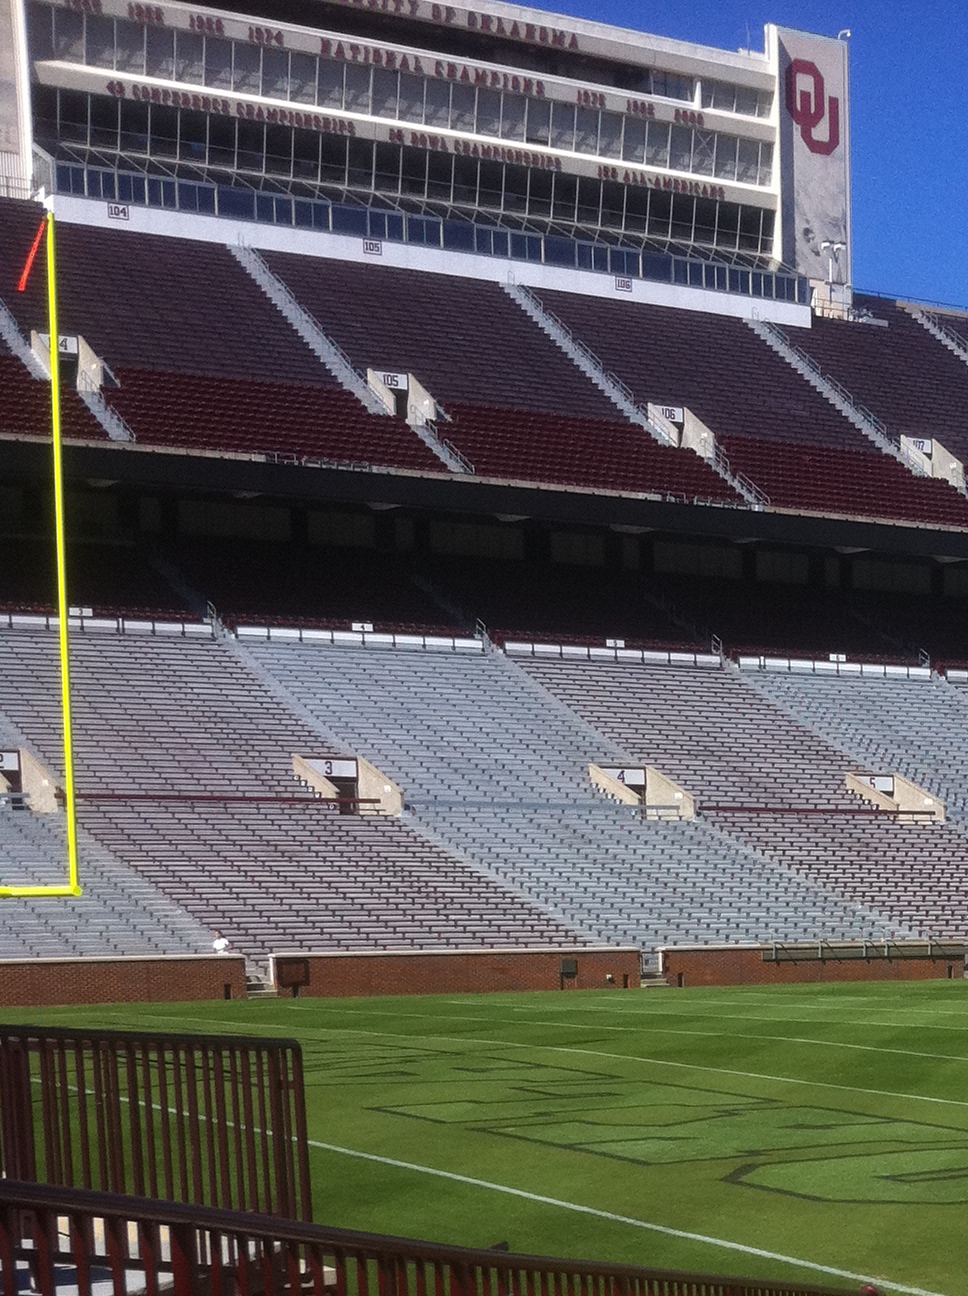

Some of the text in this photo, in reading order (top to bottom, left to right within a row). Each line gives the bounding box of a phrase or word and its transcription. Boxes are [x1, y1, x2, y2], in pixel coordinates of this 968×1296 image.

[432, 3, 456, 23] OF
[467, 11, 579, 49] OKLAHOMA
[321, 38, 424, 75] NATIONAL
[434, 60, 545, 97] CHAMPIONS
[132, 84, 230, 115] CONFERENCE
[236, 102, 356, 136] CHAMPIONSHIPS
[785, 58, 839, 156] OU
[411, 131, 448, 152] BOWL
[454, 139, 562, 171] CHAMPIONSHIPS
[623, 169, 725, 200] ALL-AMERICANS
[110, 205, 127, 217] 104
[365, 241, 380, 252] 105
[617, 279, 630, 289] 106
[383, 373, 399, 387] 105
[325, 760, 333, 775] 3
[617, 770, 625, 783] 4
[869, 777, 876, 789] 5
